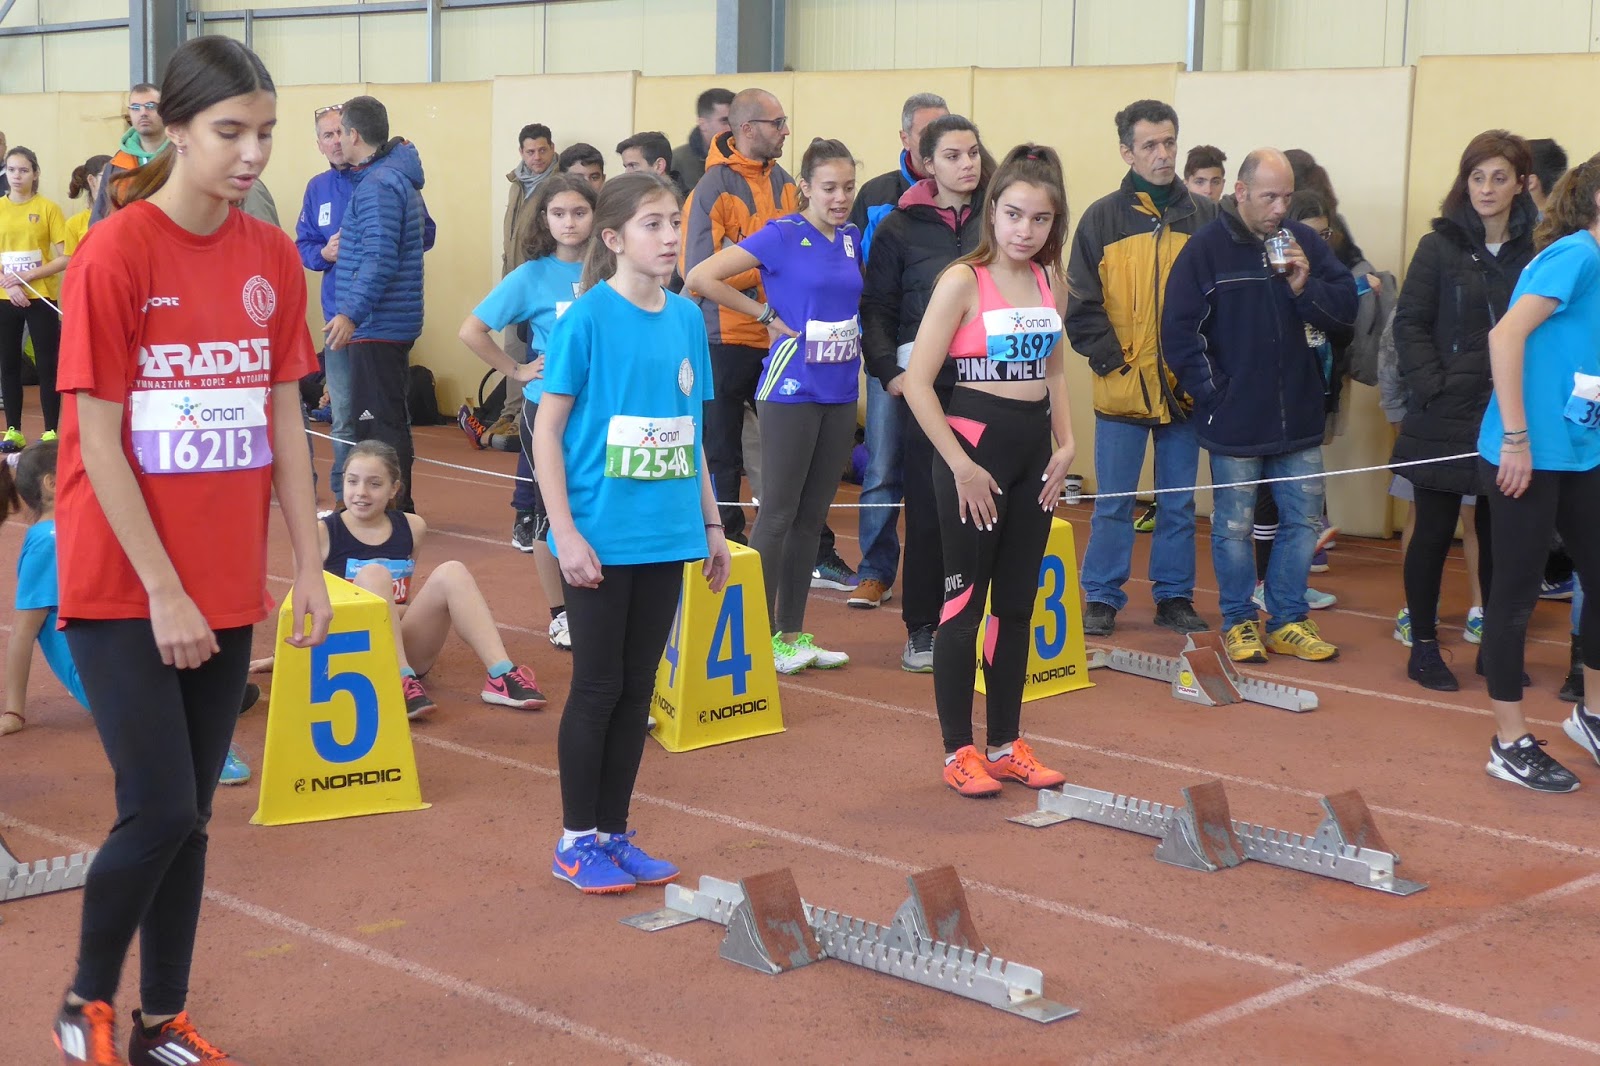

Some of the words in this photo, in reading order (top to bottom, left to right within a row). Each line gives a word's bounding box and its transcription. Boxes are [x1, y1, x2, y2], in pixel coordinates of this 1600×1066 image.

[956, 357, 1001, 381] PINK
[1006, 359, 1033, 380] ME
[1035, 358, 1047, 379] U
[158, 428, 253, 470] 16213
[620, 446, 690, 478] 12548
[1034, 554, 1067, 660] 3
[706, 583, 753, 696] 4
[1032, 664, 1076, 684] NORDIC
[310, 629, 380, 764] 5
[710, 698, 767, 721] NORDIC
[311, 768, 402, 792] NORDIC
